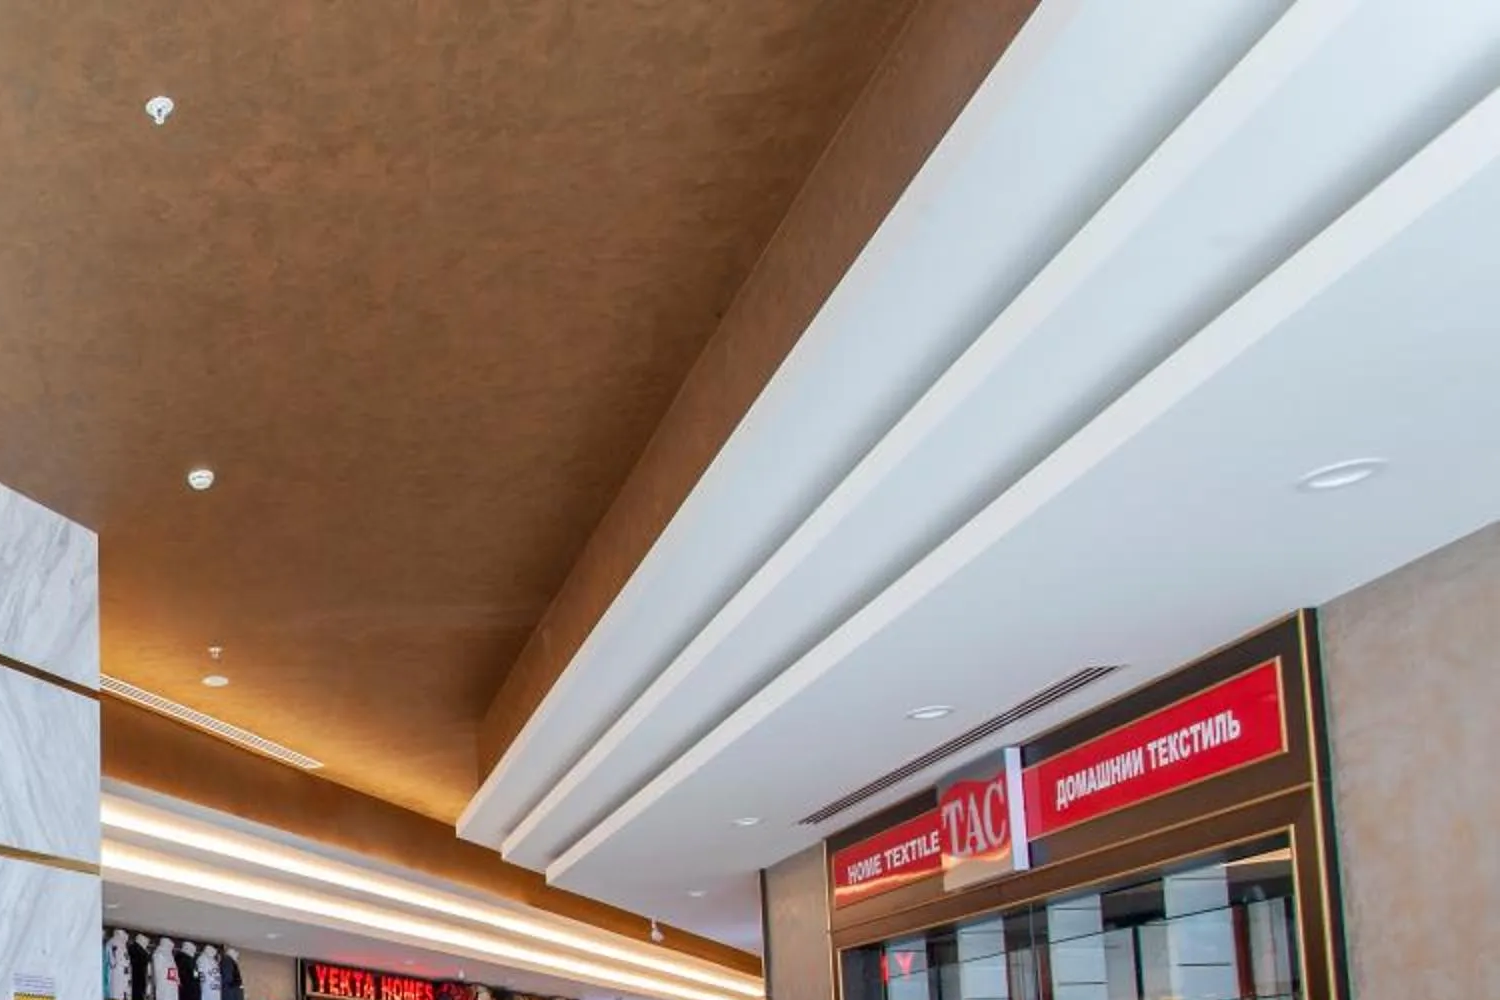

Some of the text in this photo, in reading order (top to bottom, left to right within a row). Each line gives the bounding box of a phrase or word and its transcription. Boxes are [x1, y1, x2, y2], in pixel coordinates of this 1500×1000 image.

[1148, 709, 1242, 770] ТЕКСТИЛЬ
[941, 778, 1007, 859] TAC
[847, 829, 941, 885] HOME TEXTILE
[315, 963, 376, 1000] YEKTA
